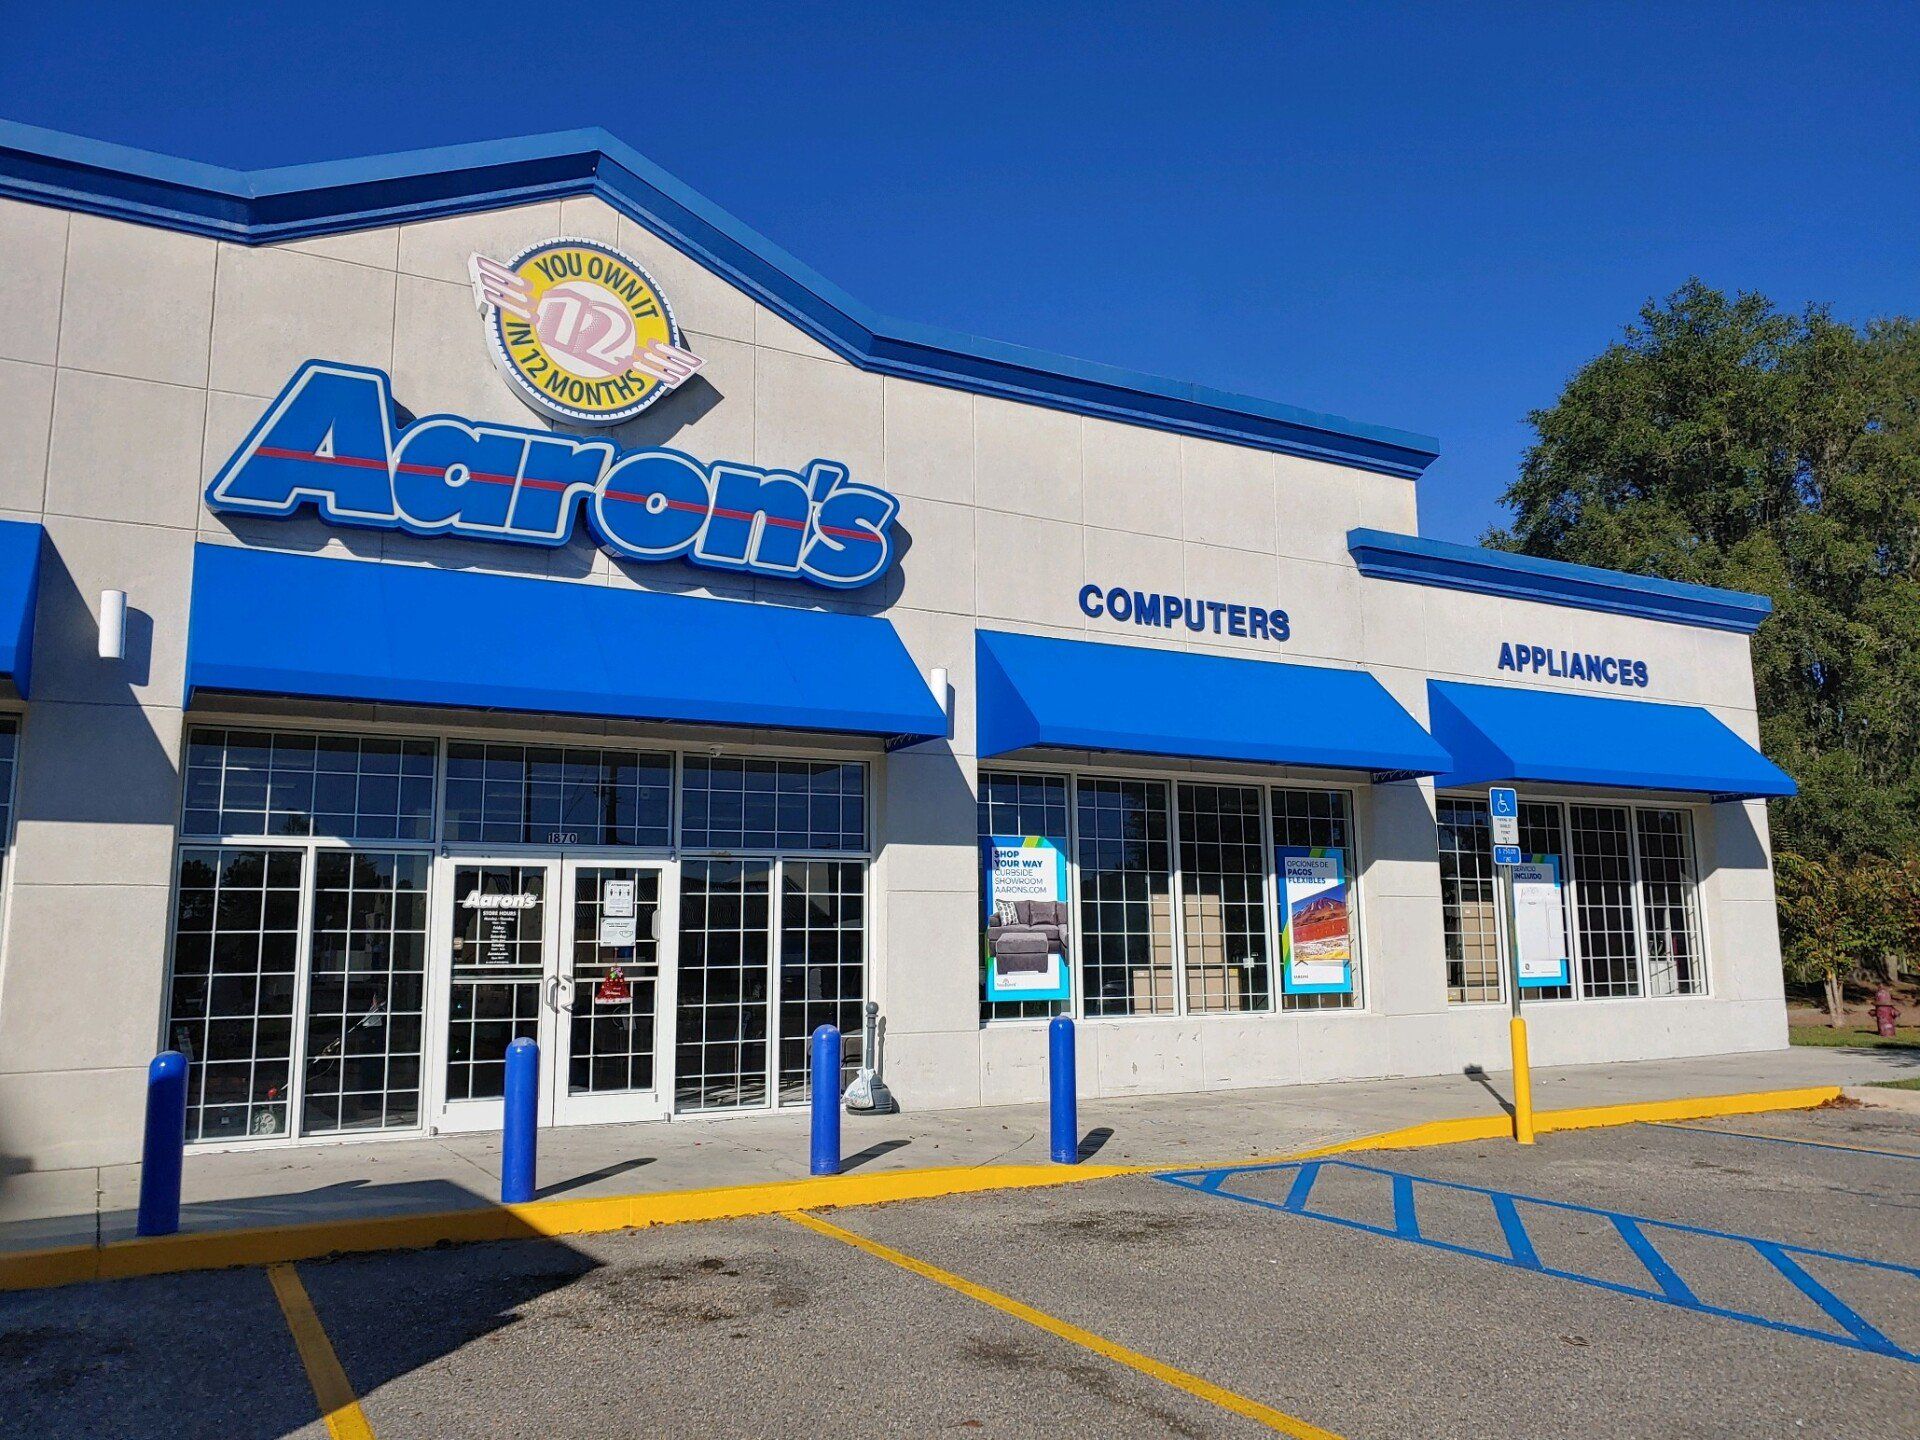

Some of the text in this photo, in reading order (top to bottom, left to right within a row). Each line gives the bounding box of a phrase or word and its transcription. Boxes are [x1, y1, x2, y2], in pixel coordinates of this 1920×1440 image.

[534, 252, 659, 320] YOU OWN IT
[506, 321, 646, 406] IN 12 MONTHS
[206, 360, 899, 588] Aaron's
[1078, 583, 1291, 642] COMPUTERS
[1498, 642, 1650, 688] APPLIANCES
[549, 833, 577, 844] 1870
[994, 850, 1019, 858] SHOP
[994, 860, 1042, 868] YOUR WAY
[994, 877, 1043, 885] SHOWROOM
[462, 890, 538, 909] Aaron's
